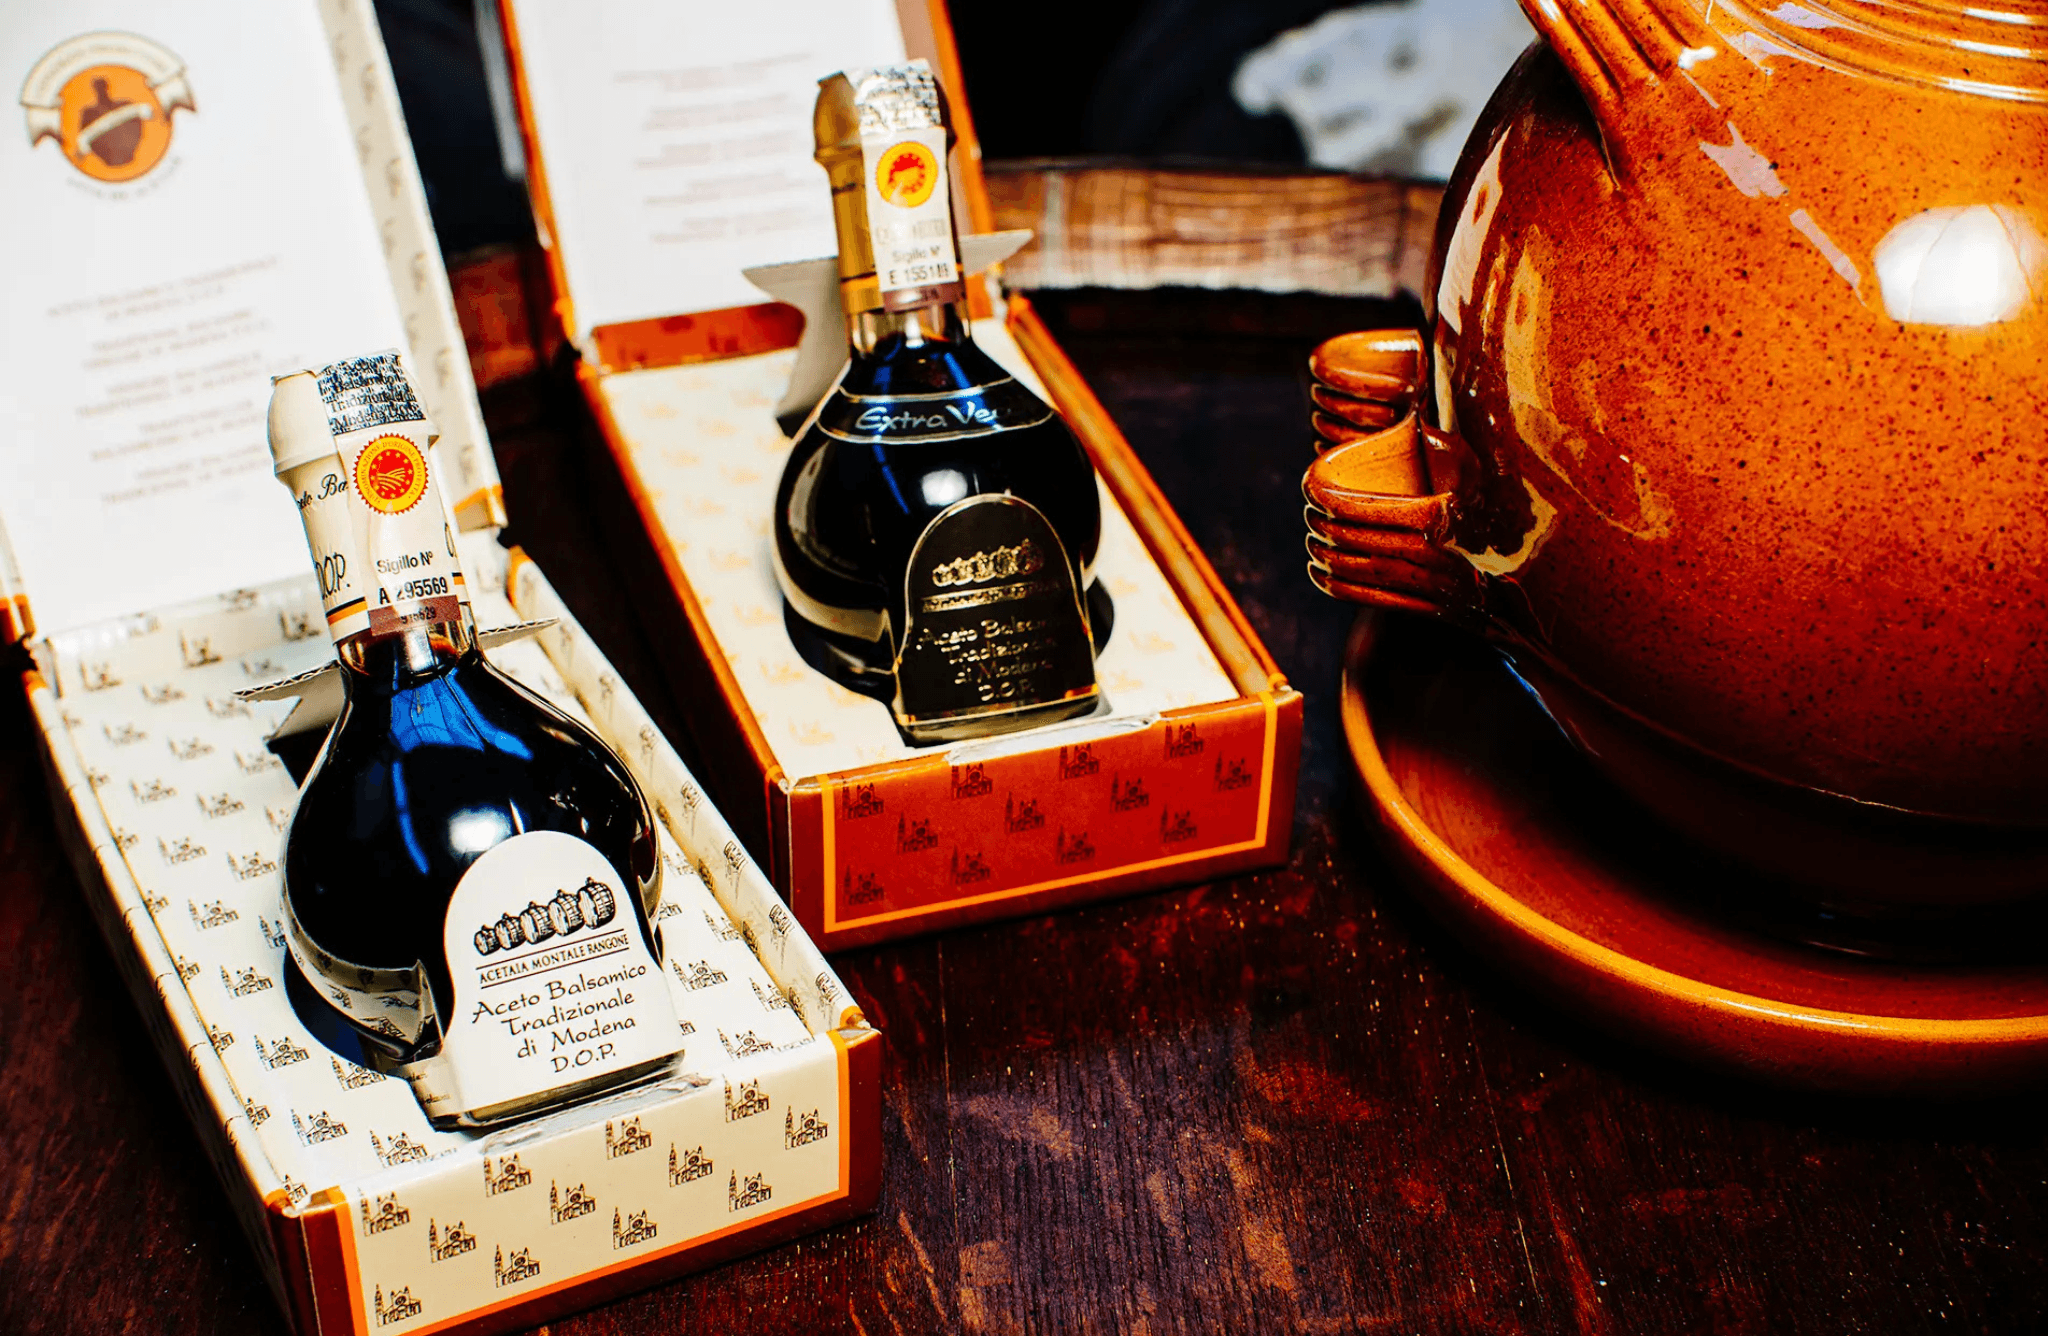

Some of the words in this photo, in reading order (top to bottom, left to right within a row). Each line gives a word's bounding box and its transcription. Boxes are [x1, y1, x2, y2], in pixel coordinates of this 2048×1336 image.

[855, 407, 947, 432] Extra
[376, 554, 418, 575] Sigillo
[379, 587, 391, 605] A
[396, 576, 449, 601] 295569
[480, 961, 528, 984] ACETAIA
[532, 946, 587, 969] MONTALE
[588, 933, 629, 955] RANGONE
[472, 993, 540, 1024] Aceto
[545, 964, 646, 1000] Balsamico
[501, 988, 635, 1036] Tradizionale
[517, 1038, 537, 1059] di
[551, 1016, 636, 1052] Modena
[551, 1043, 616, 1073] D.O.P.
